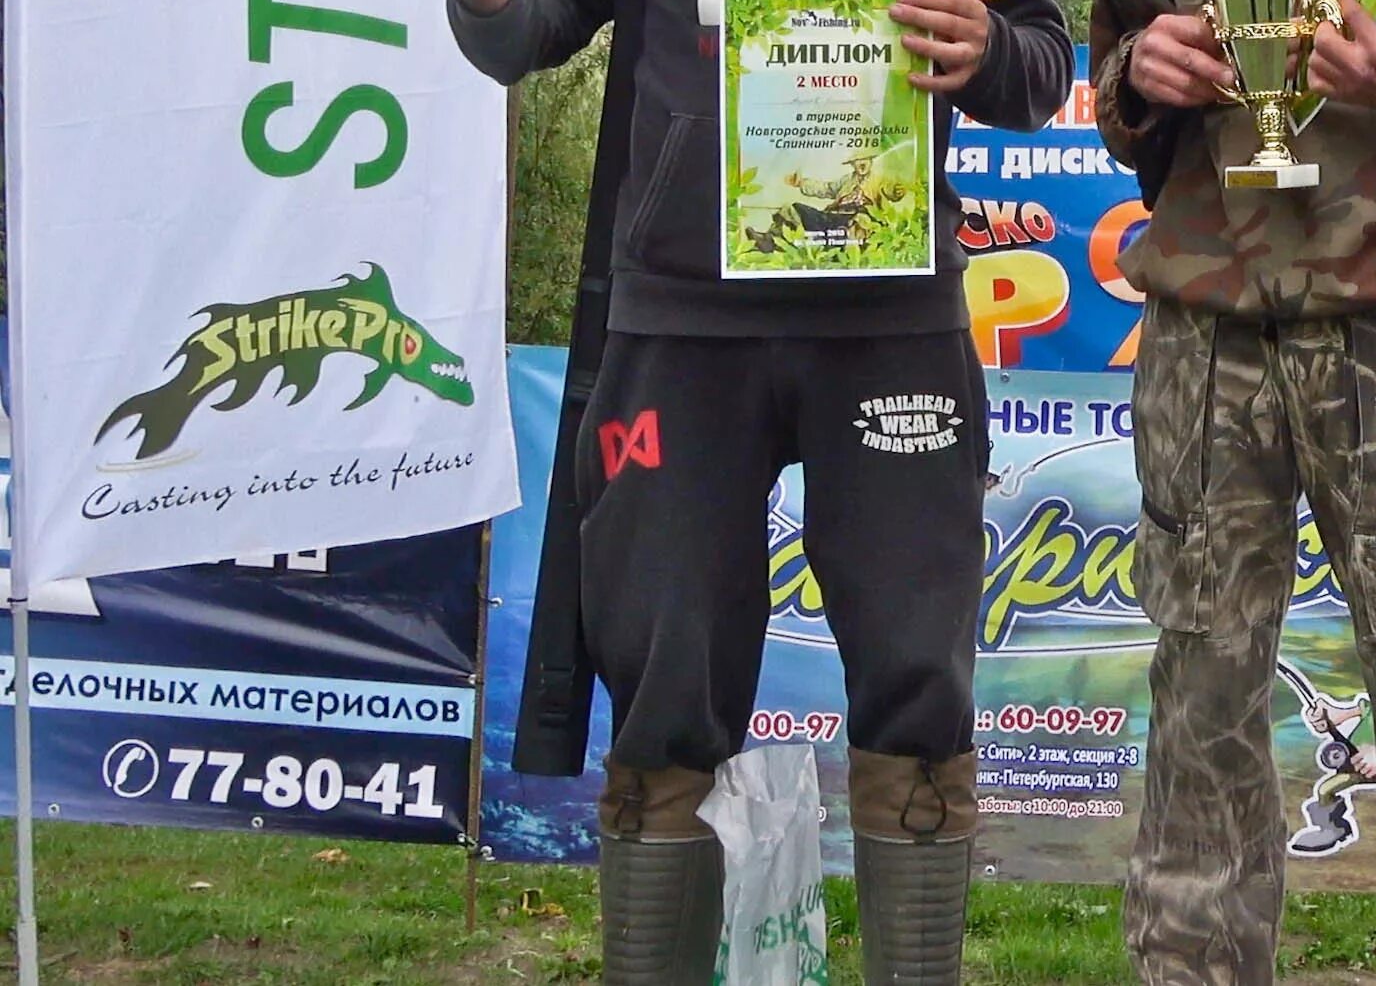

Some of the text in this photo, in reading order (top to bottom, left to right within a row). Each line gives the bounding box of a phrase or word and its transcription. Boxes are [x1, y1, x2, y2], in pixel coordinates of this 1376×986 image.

[765, 43, 892, 67] ДИПЛОМ
[796, 75, 858, 88] 2 МЕСТО
[806, 112, 861, 124] турнире
[746, 124, 909, 138] Новгородские порыбалки
[859, 394, 957, 417] TRAILHEAD
[879, 413, 940, 434] WEAR
[862, 427, 959, 454] INDASTREE
[82, 450, 475, 521] Casting into the future
[210, 685, 461, 724] материалов
[998, 705, 1126, 735] 60-09-97
[1028, 745, 1036, 761] 2
[1039, 748, 1070, 765] этаж,
[1073, 750, 1115, 767] секция
[1116, 747, 1139, 765] 2-8
[167, 748, 445, 820] 77-80-41
[1096, 771, 1118, 789] 130
[1032, 799, 1068, 814] 10:00
[1069, 801, 1087, 818] до
[1088, 800, 1123, 816] 21:00
